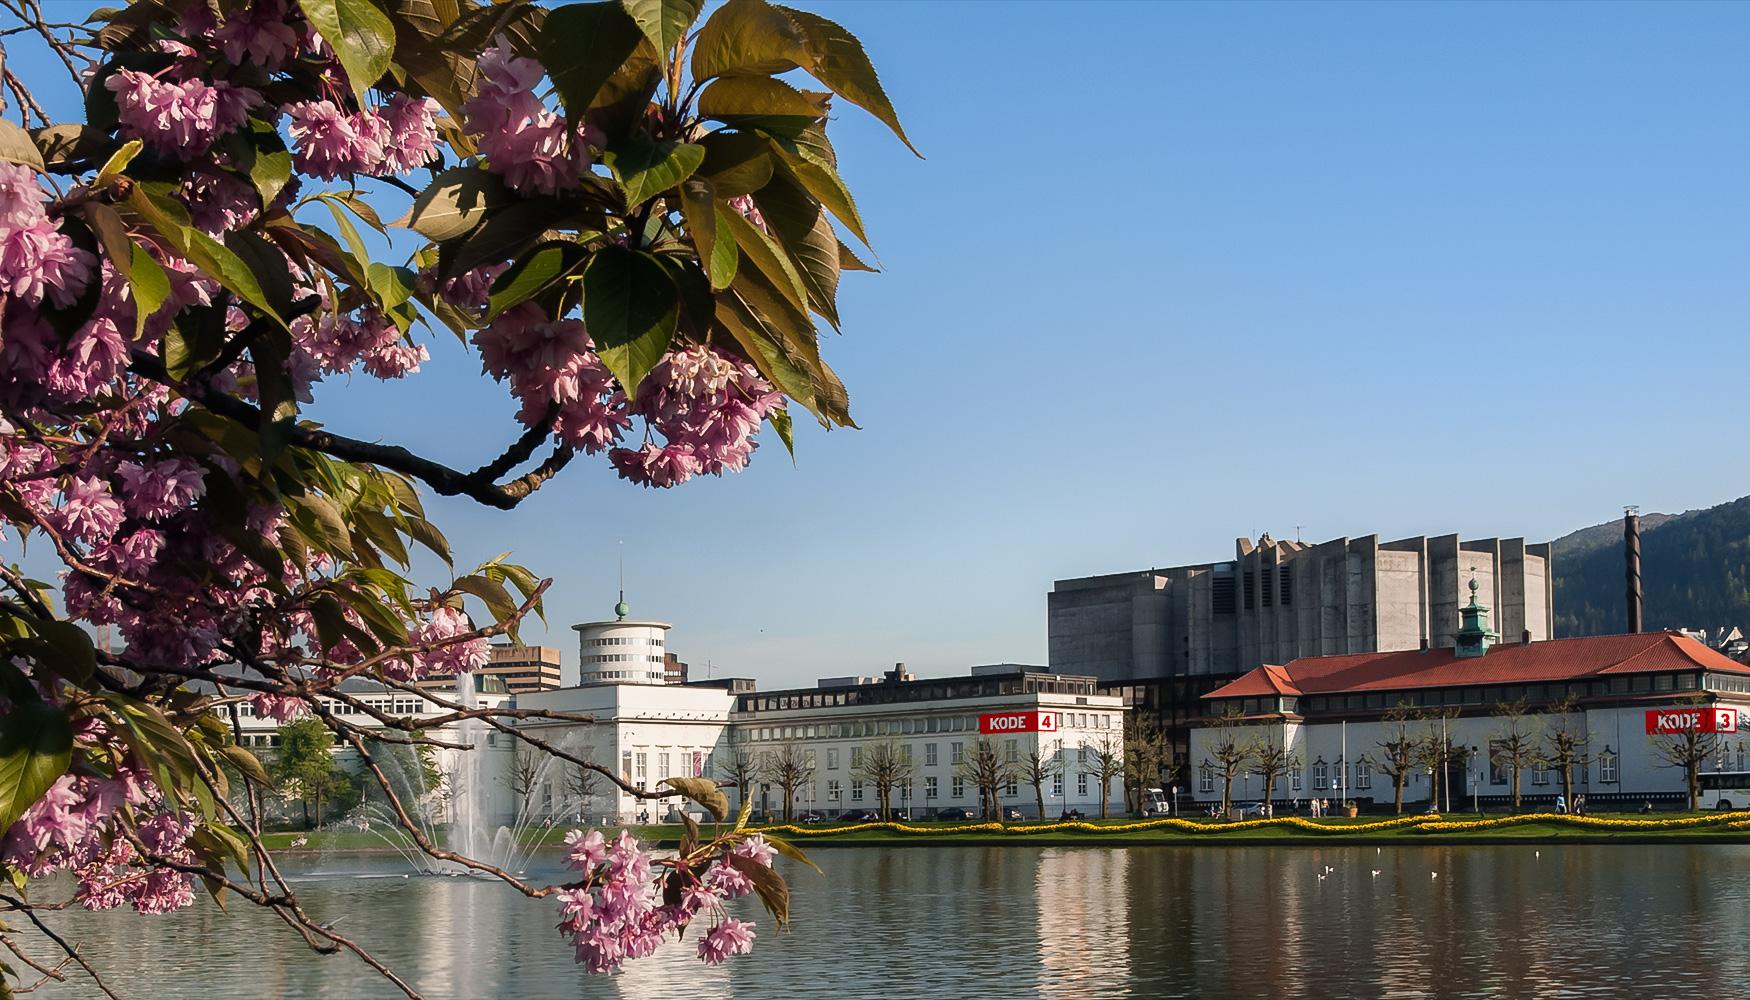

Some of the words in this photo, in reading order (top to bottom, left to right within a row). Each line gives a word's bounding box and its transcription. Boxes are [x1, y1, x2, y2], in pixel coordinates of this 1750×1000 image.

[990, 716, 1026, 730] KODE
[1042, 715, 1051, 728] 4
[1658, 713, 1701, 729] KODE
[1721, 713, 1731, 728] 3
